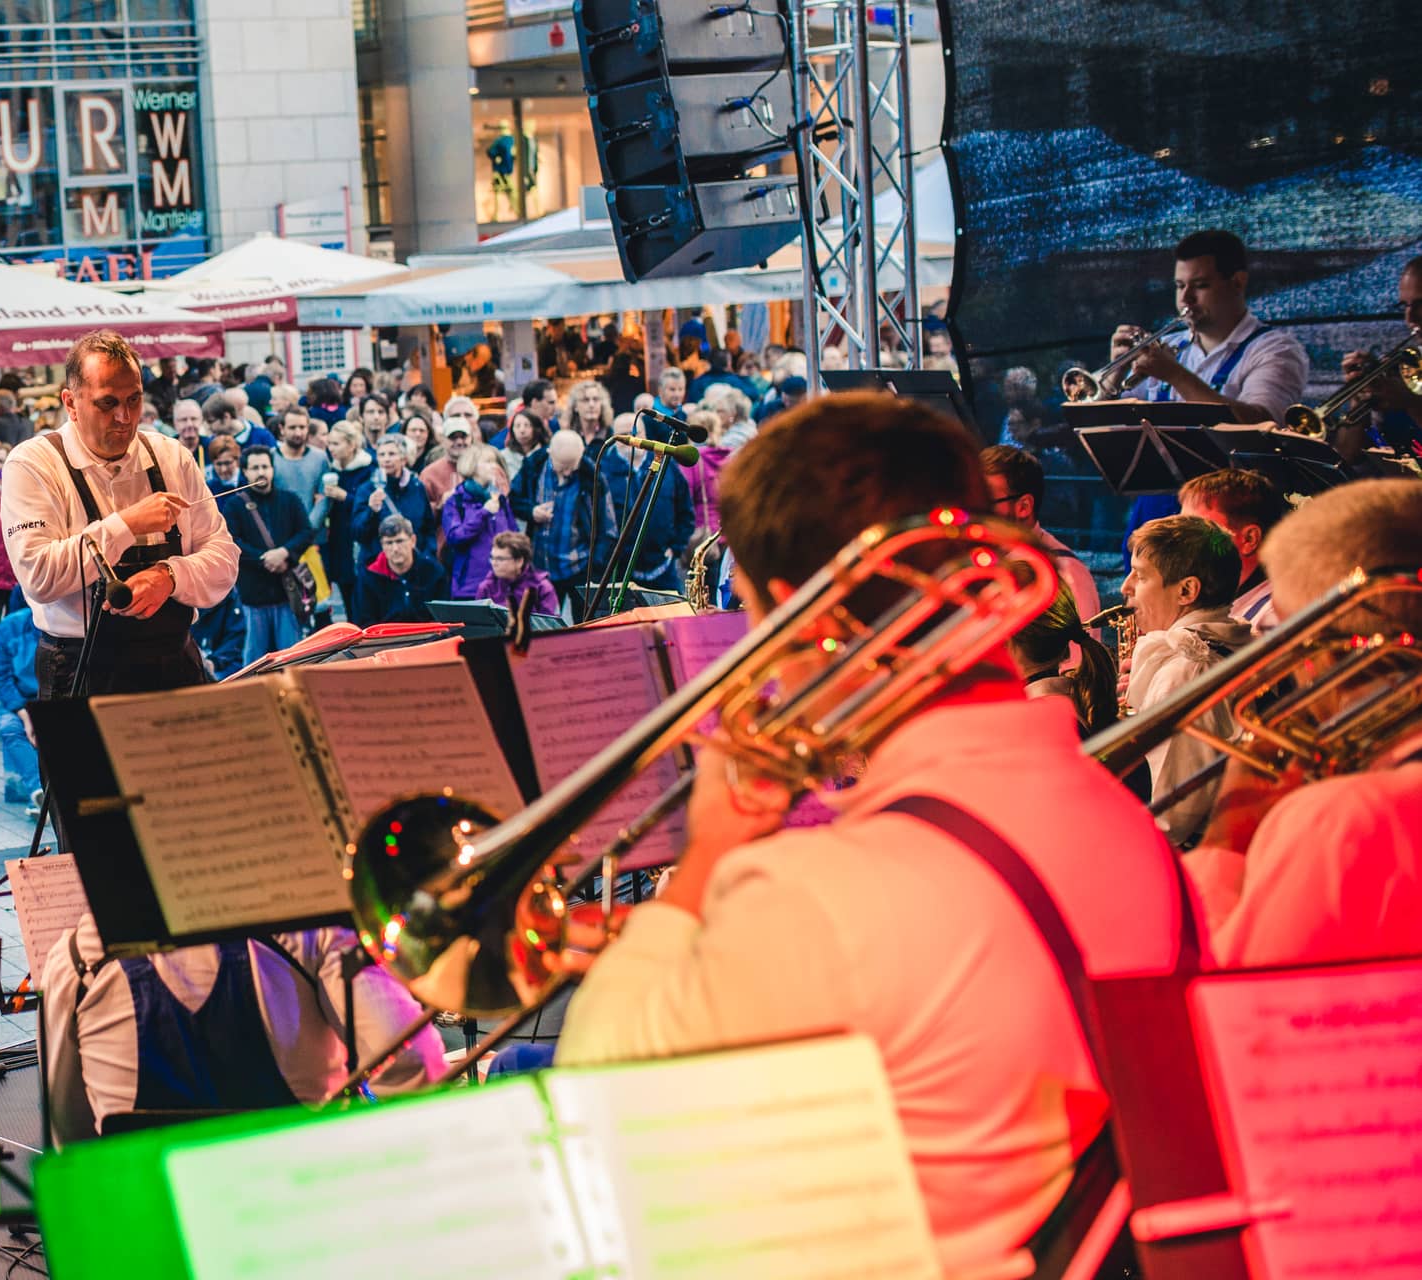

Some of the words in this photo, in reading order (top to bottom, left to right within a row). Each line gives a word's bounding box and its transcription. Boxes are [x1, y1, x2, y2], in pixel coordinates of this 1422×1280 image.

[131, 89, 196, 110] Werner
[150, 112, 186, 159] W
[152, 159, 191, 207] M
